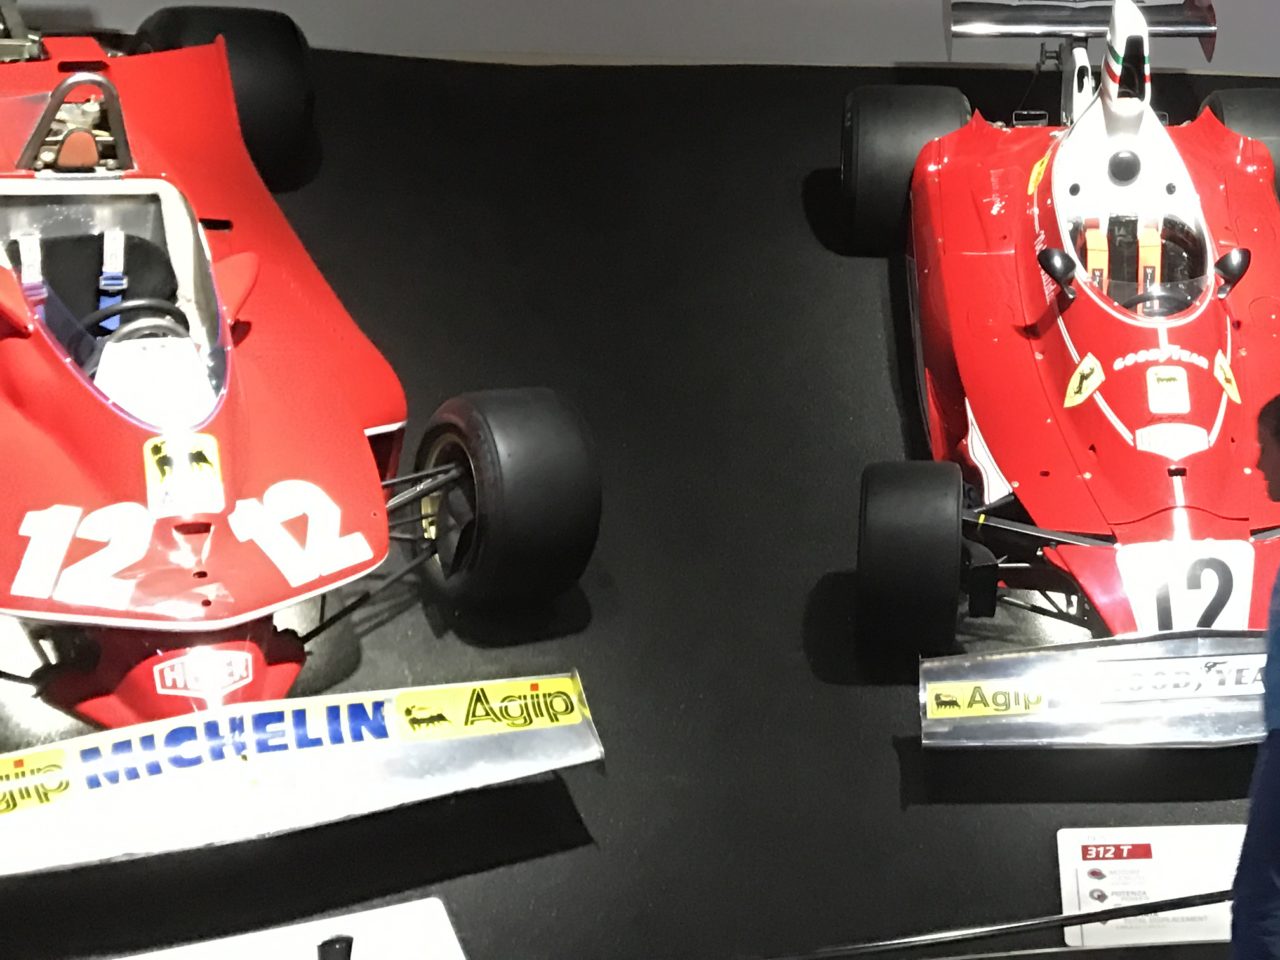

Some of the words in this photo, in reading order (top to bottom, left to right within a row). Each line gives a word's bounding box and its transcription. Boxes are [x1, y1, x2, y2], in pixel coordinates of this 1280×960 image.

[10, 503, 158, 611] 12
[227, 479, 374, 588] 12
[1156, 557, 1234, 631] 12
[80, 701, 389, 790] MICHELIN
[464, 683, 575, 728] Agip
[967, 686, 1042, 712] Agip
[1086, 846, 1115, 858] 312
[1119, 845, 1132, 857] T
